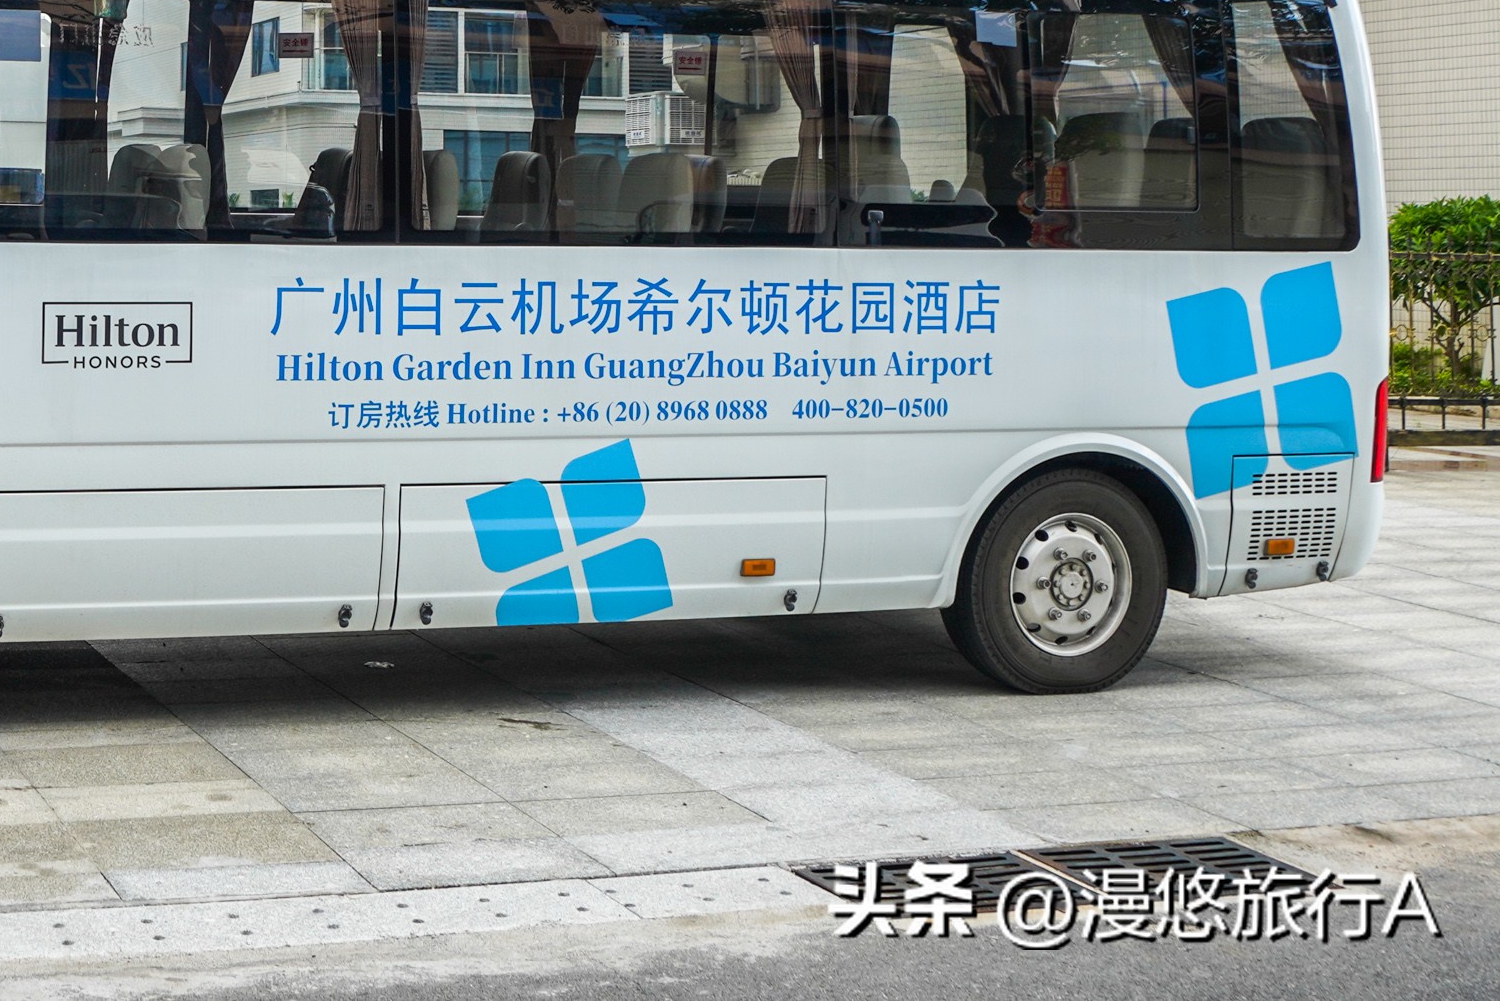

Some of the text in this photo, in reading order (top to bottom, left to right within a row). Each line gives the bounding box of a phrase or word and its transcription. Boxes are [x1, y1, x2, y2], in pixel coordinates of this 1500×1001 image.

[270, 277, 1001, 337] 广州白云机场希尔顿花园酒店
[54, 314, 181, 348] Hilton
[73, 355, 161, 369] HONORS
[276, 349, 993, 387] Hilton Garden Inn GuangZhou Baiyun Airport
[328, 400, 441, 430] 订房热线
[656, 400, 710, 422] 8968
[715, 399, 769, 421] 0888
[792, 397, 950, 420] 400-820-0500
